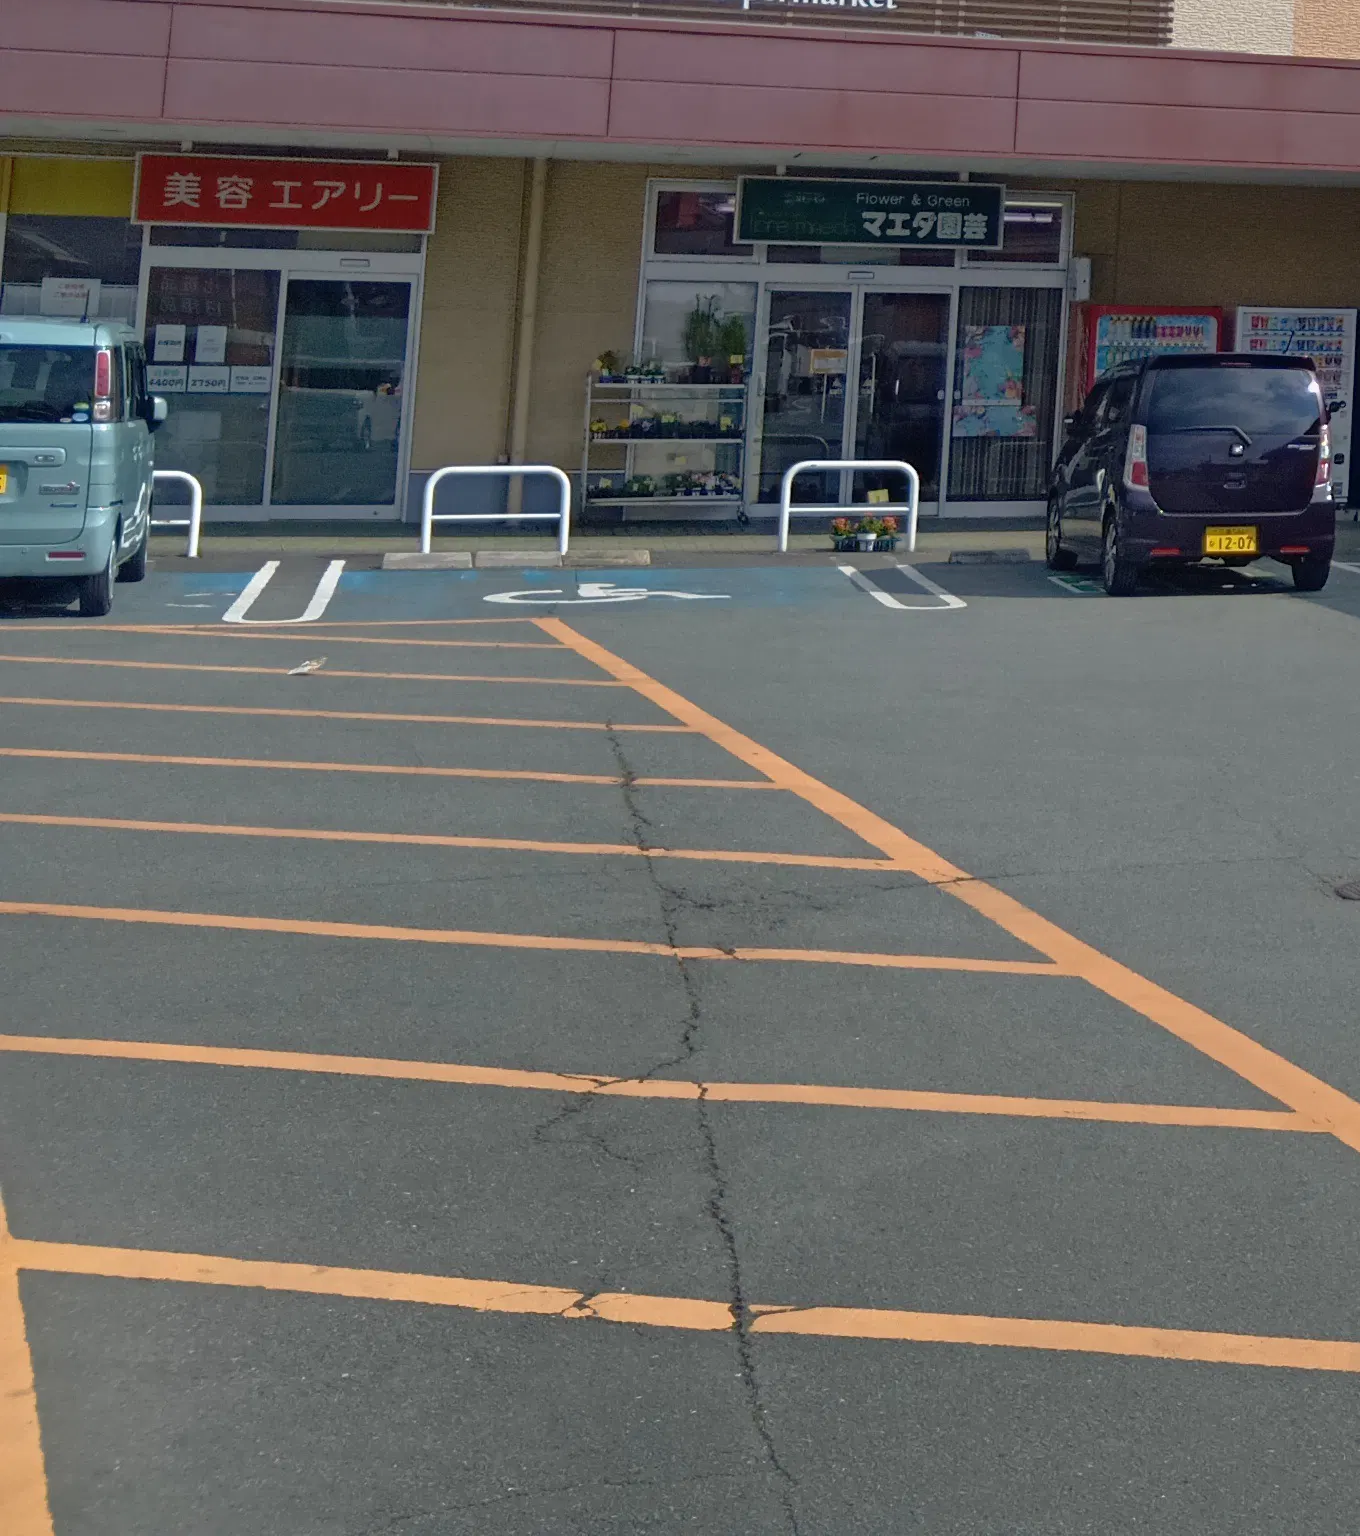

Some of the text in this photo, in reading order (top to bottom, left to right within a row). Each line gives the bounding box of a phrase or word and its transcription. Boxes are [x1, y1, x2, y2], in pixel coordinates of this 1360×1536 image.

[163, 171, 419, 212] 美容 エアリー
[856, 192, 971, 208] Flower & Green
[861, 211, 989, 240] マエダ園芸
